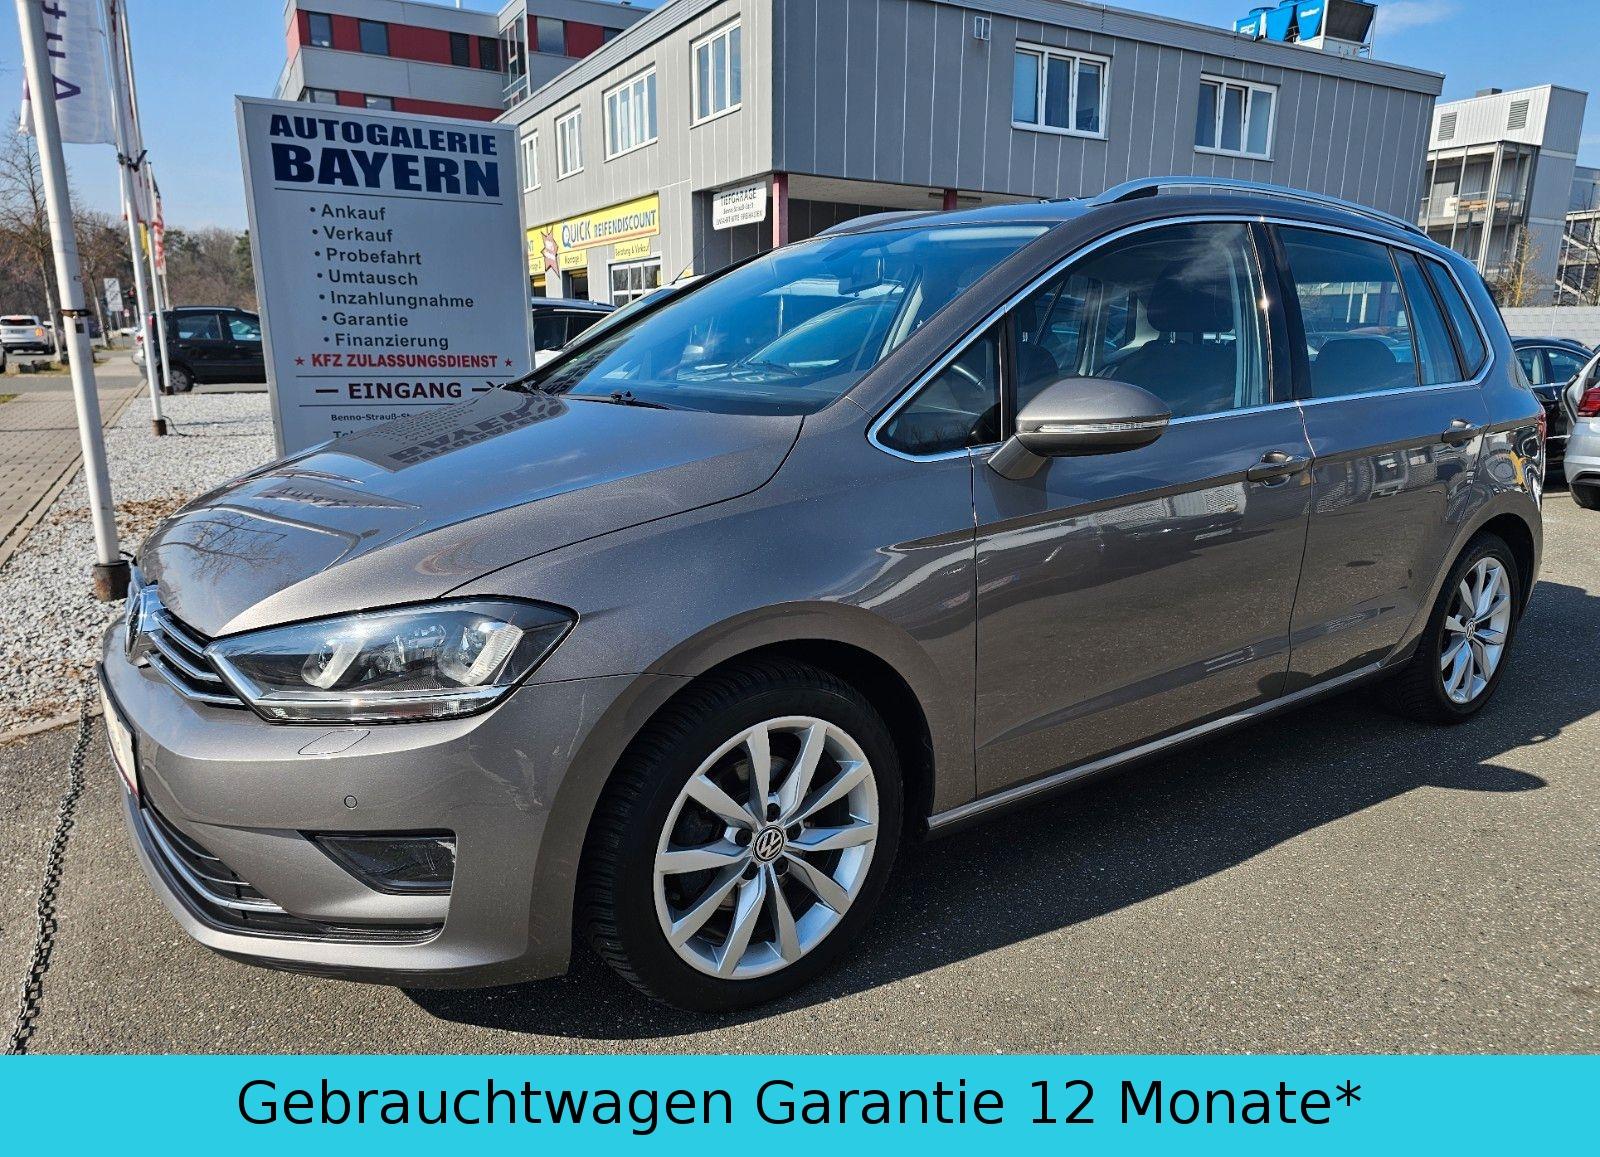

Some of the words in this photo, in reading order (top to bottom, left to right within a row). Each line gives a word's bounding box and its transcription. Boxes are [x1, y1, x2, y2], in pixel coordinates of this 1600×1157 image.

[270, 114, 498, 156] AUTOGALERIE
[270, 142, 500, 197] BAYERN
[321, 203, 387, 221] Ankauf
[323, 225, 393, 243] Verkauf
[561, 219, 592, 248] QUICK
[593, 209, 656, 238] REIFENDISCOUNT
[326, 247, 422, 266] Probefahrt
[328, 268, 418, 286] Umtausch
[330, 290, 474, 309] Inzahlungnahme
[333, 311, 409, 327] Garantie
[335, 332, 449, 350] Finanzierung
[312, 353, 342, 368] KFZ
[347, 353, 498, 369] ZULASSUNGSDIENST
[348, 382, 462, 400] EINGANG
[330, 412, 410, 422] Benno-Strauß-S
